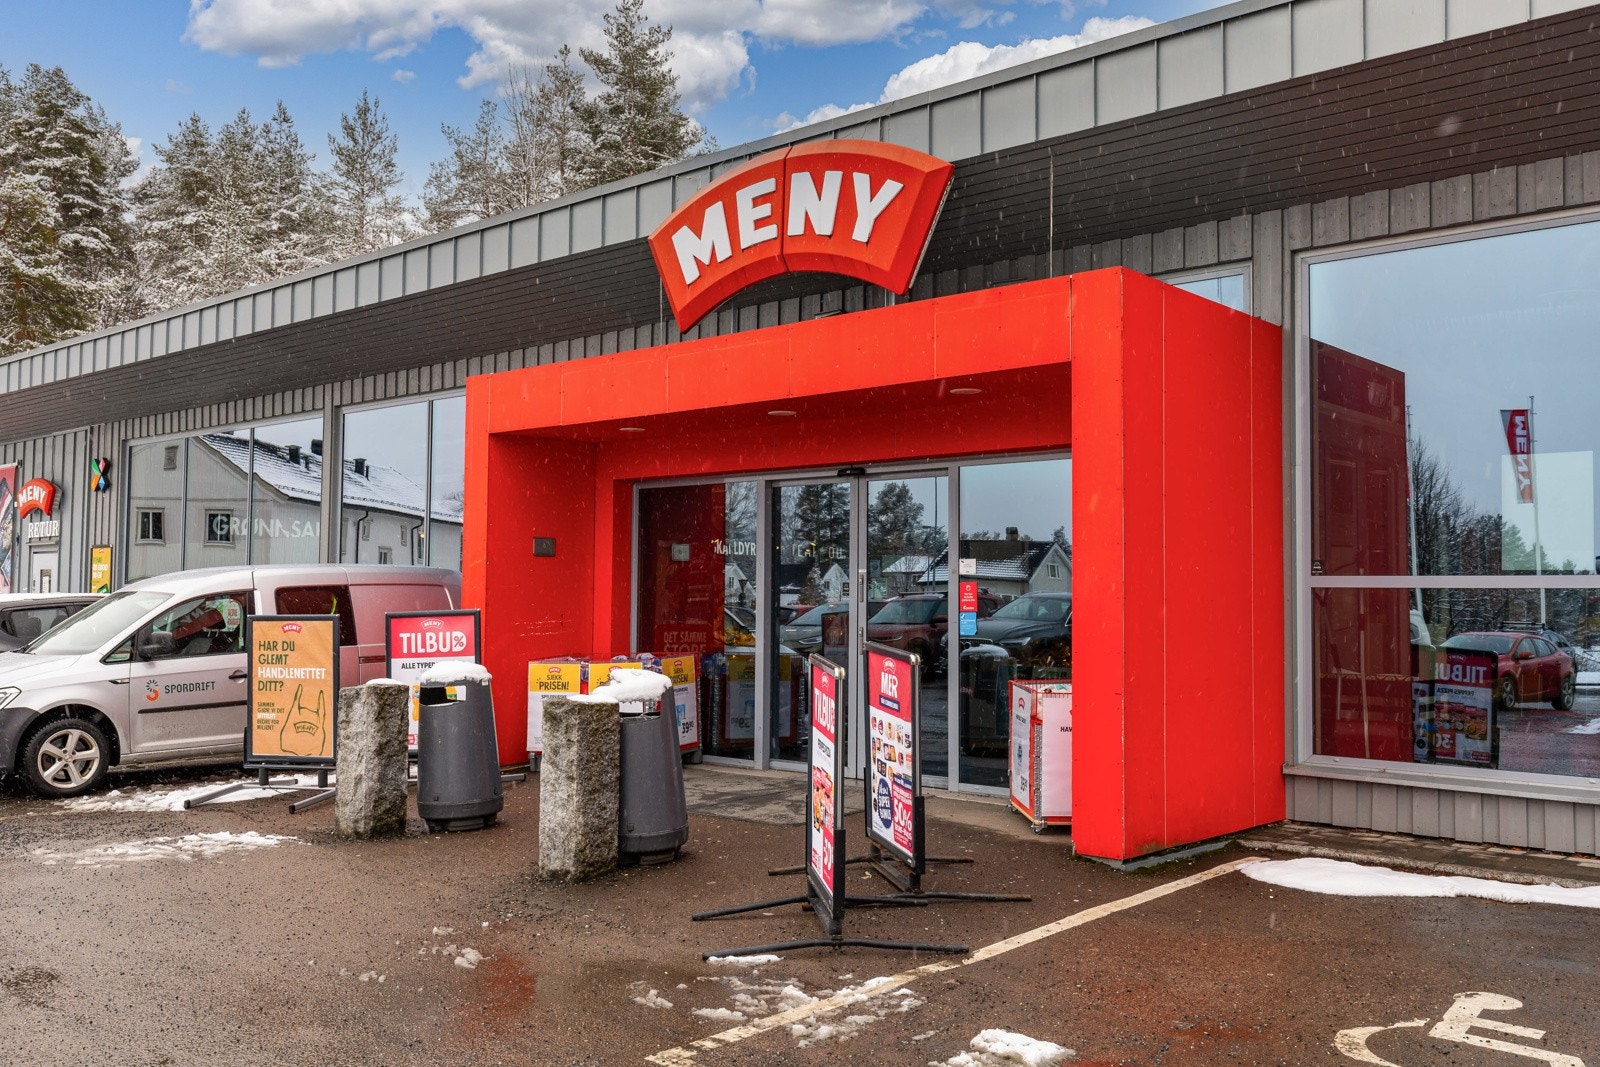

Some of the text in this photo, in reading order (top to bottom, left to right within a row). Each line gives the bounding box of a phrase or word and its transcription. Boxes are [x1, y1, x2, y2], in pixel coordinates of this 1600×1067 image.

[671, 170, 904, 285] MENY
[18, 485, 46, 507] MENY
[28, 520, 60, 538] RETUR
[212, 515, 320, 538] GRØNNSA
[284, 624, 300, 632] MENY
[258, 640, 295, 652] HAR DU
[258, 653, 289, 665] GLEMT
[257, 667, 326, 679] HANDLENETTET
[164, 682, 216, 694] SPORDRIFT
[257, 680, 284, 692] DITT?
[539, 681, 570, 691] PRISEN!
[881, 671, 898, 698] MER
